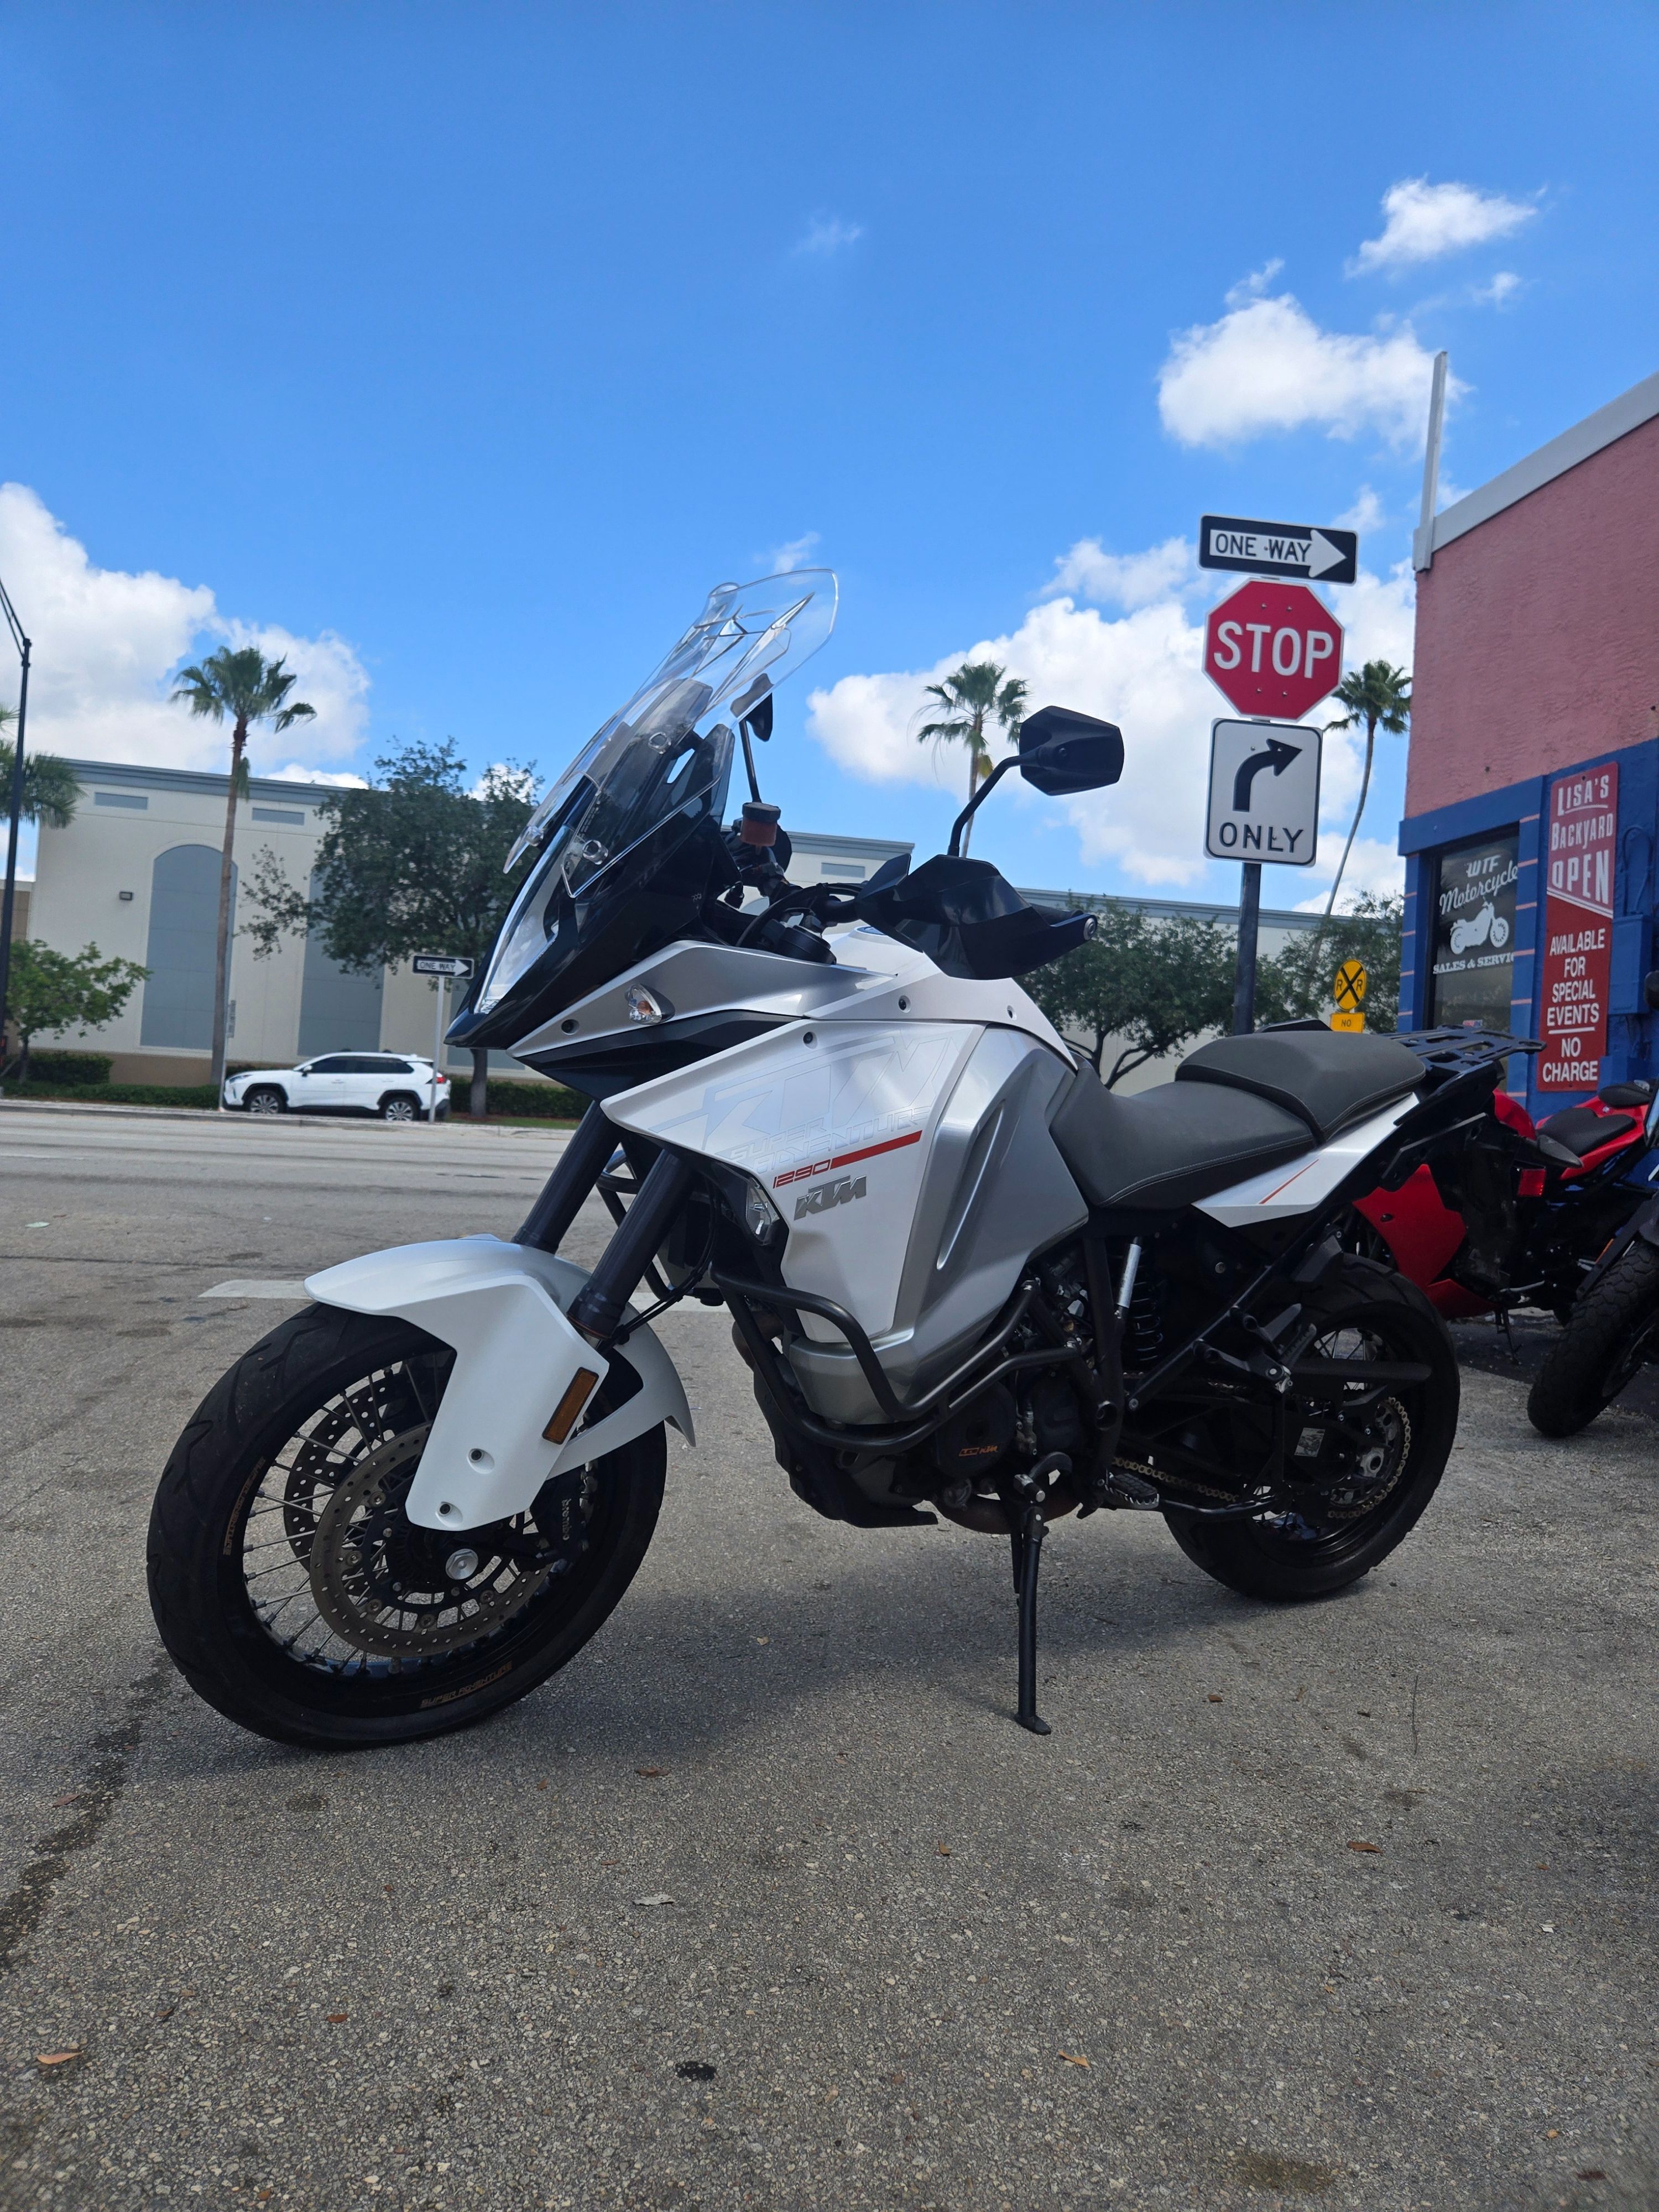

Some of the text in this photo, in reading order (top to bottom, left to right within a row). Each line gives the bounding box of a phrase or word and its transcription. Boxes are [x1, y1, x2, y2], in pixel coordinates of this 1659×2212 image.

[1214, 533, 1311, 563] ONE WAY
[1213, 620, 1334, 679] STOP
[1219, 822, 1303, 853] ONLY
[1466, 855, 1501, 878] WTF
[1552, 849, 1609, 904] OPEN
[1550, 928, 1606, 956] AVAILABLE
[439, 963, 456, 972] WAY
[1433, 959, 1466, 975] SALES
[1467, 958, 1476, 969] &
[1564, 956, 1586, 978] FOR
[1552, 978, 1596, 1003] SPECIAL
[1546, 1003, 1599, 1027] EVENTS
[1561, 1036, 1582, 1058] NO
[1542, 1060, 1598, 1083] CHARGE
[728, 1117, 828, 1161] SUPER
[773, 1159, 831, 1189] 1290
[794, 1175, 867, 1221] KTM
